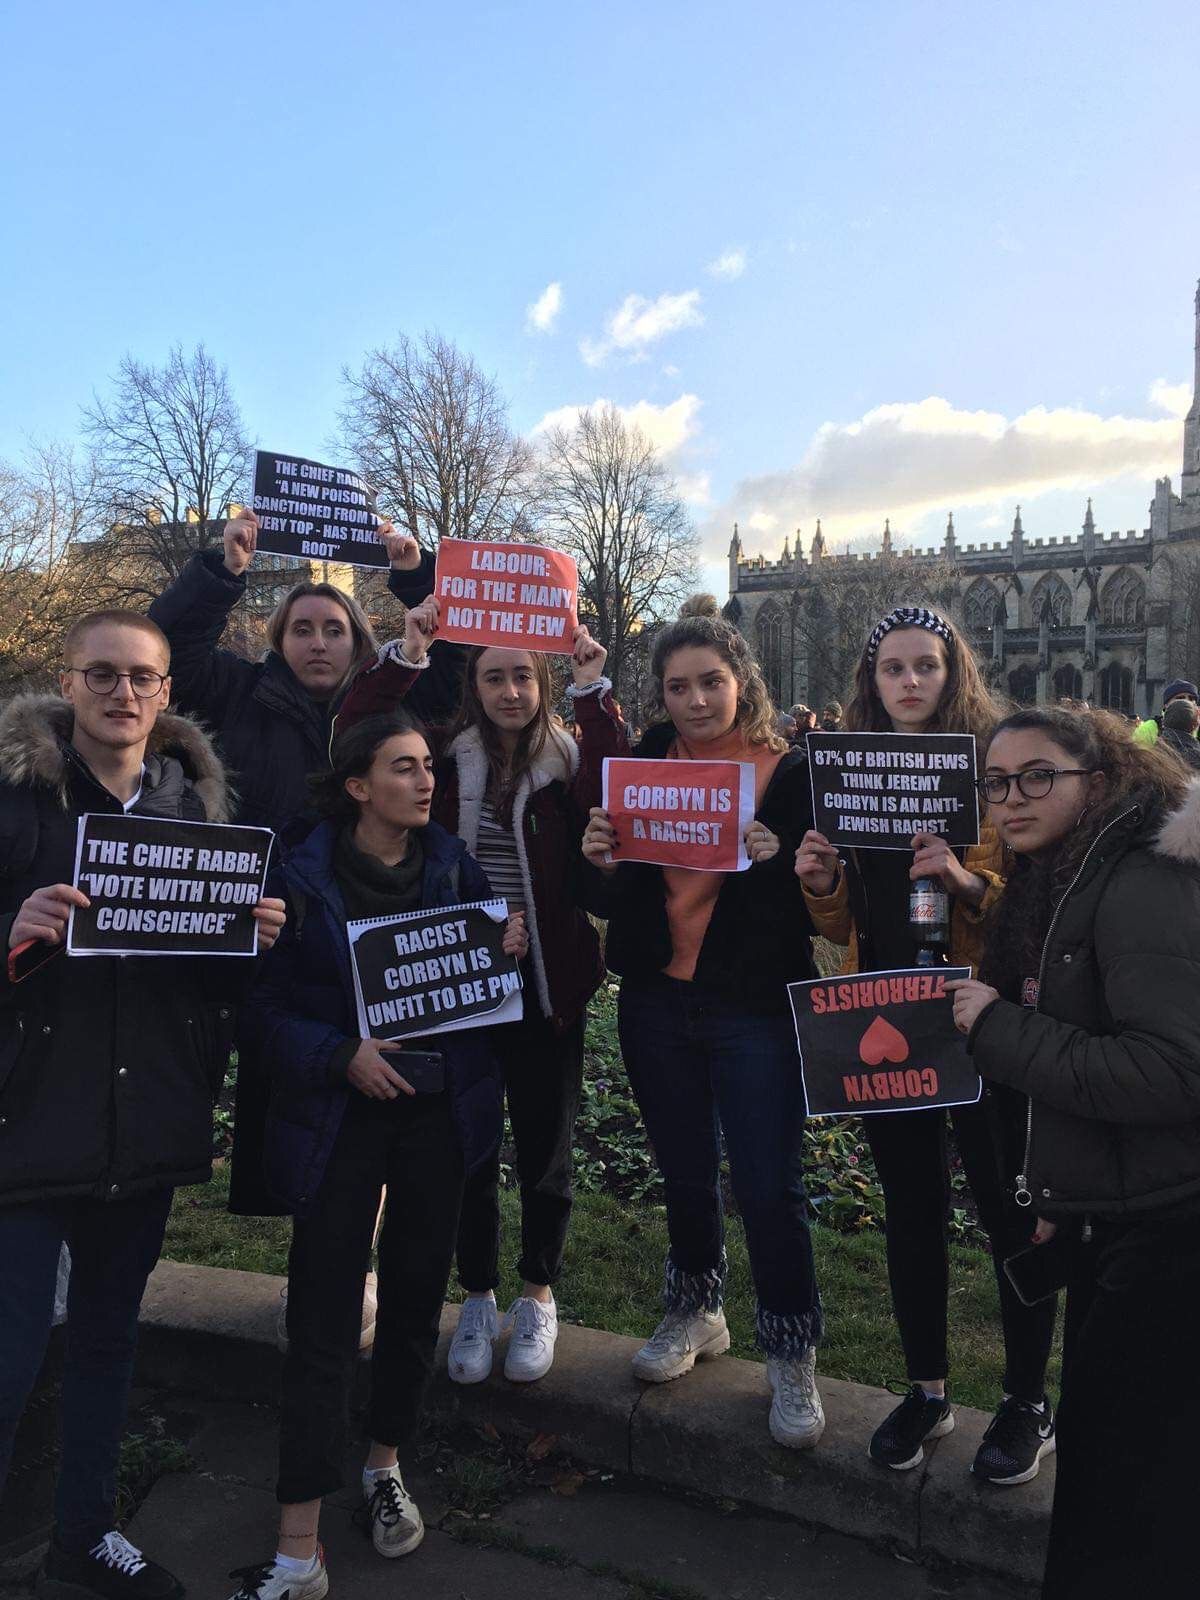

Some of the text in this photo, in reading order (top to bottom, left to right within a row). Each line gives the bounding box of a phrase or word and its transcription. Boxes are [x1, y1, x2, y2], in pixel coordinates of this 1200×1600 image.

[275, 460, 298, 477] THE
[300, 464, 335, 483] CHIEF
[291, 482, 320, 499] NEW
[321, 487, 366, 506] POISON
[254, 495, 332, 519] SANCTIONED
[334, 507, 368, 525] FROM
[256, 514, 287, 532] VERY
[289, 519, 314, 535] TOP
[323, 524, 348, 541] HAS
[471, 550, 550, 577] LABOUR:
[441, 576, 572, 608] FOR THE MANY
[447, 606, 566, 637] NOT THE JEW
[815, 750, 969, 770] 87% OF BRITISH JEWS
[841, 772, 941, 792] THINK JEREMY
[623, 785, 732, 813] CORBYN IS
[823, 792, 964, 814] CORBYN IS AN ANTI-
[633, 818, 723, 846] A RACIST
[837, 815, 950, 834] JEWISH RACIST.
[86, 839, 263, 875] THE CHIEF RABBI:
[79, 872, 260, 905] “VOTE WITH YOUR
[96, 907, 237, 935] CONSCIENCE”
[394, 919, 468, 956] RACIST
[384, 946, 493, 991] CORBYN IS
[367, 970, 520, 1027] UNFIT TO BE PM
[809, 975, 947, 1015] TERRORISTS
[841, 1067, 939, 1103] CORBYN
